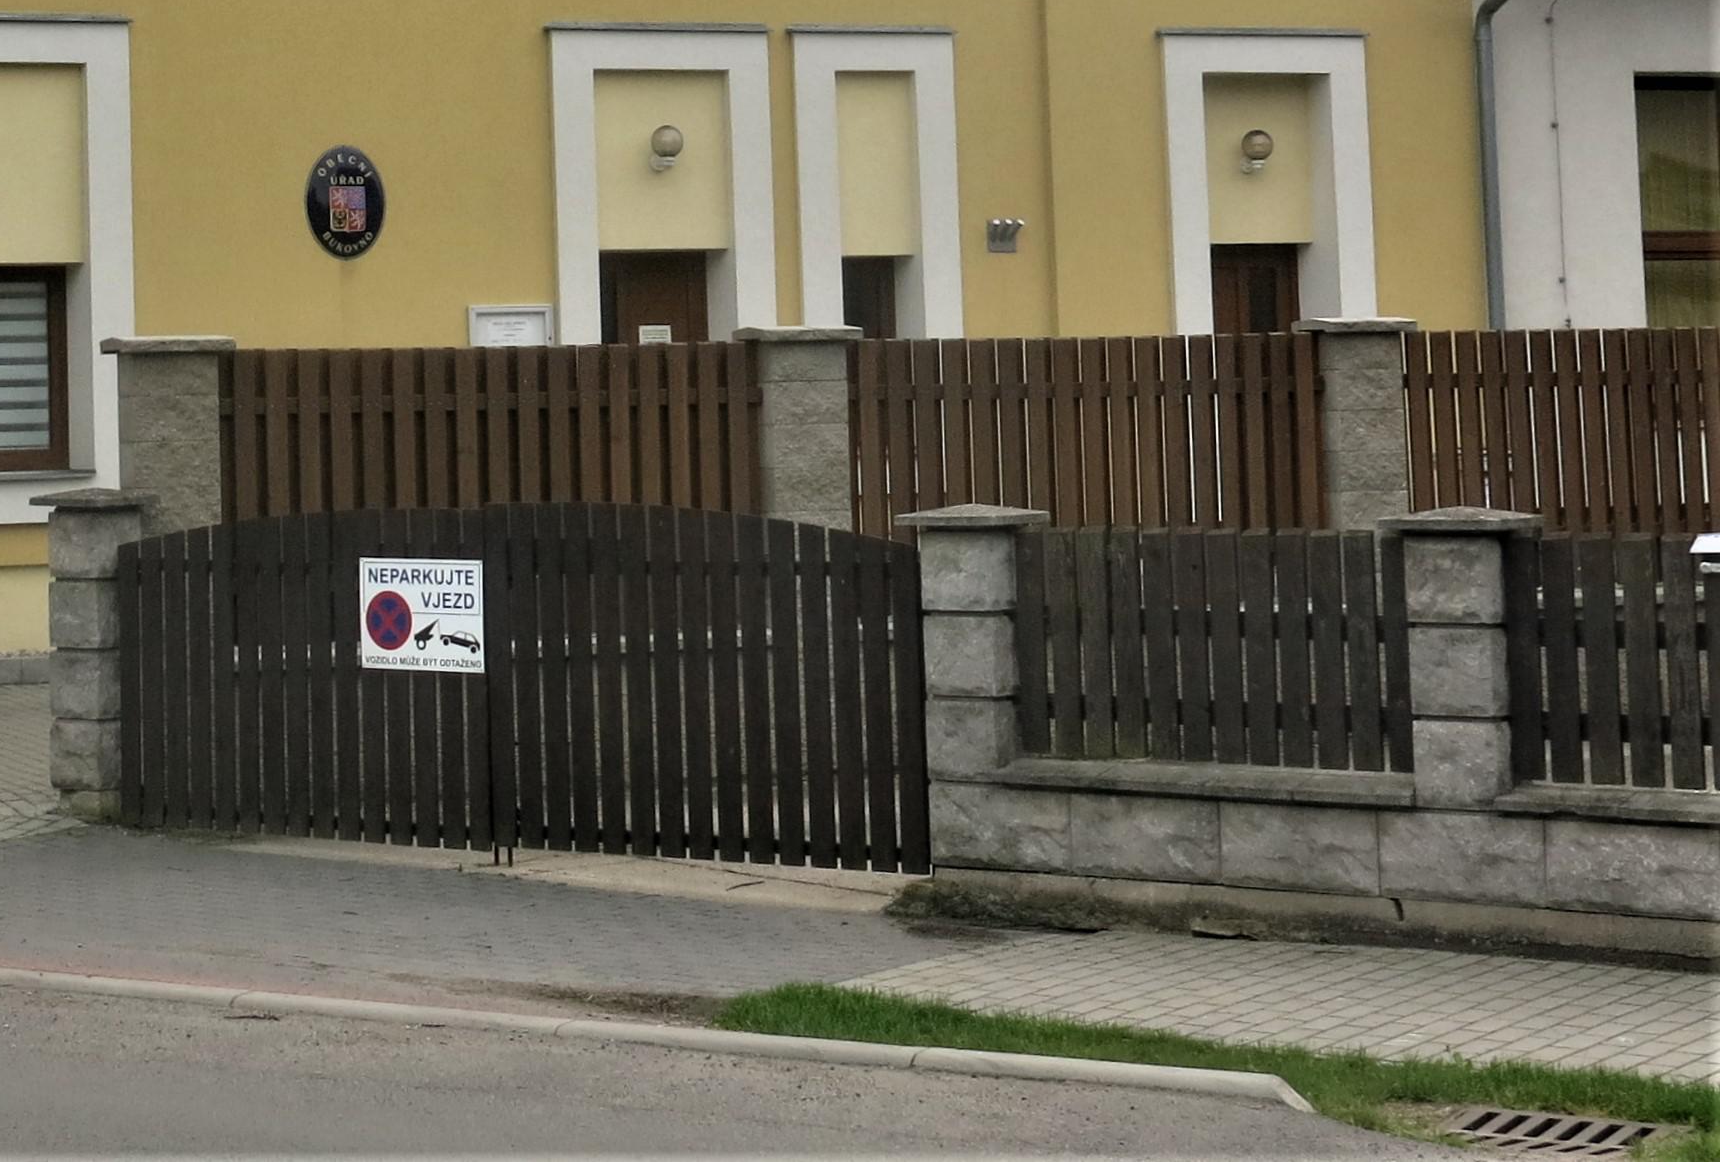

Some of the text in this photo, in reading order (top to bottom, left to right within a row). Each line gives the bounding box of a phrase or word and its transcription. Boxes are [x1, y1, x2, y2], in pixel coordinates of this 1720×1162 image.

[317, 153, 373, 178] OBECNÍ
[330, 174, 365, 185] ÚŘAD
[322, 231, 374, 253] BUKOVNO
[368, 568, 474, 586] NEPARKUJTE
[421, 592, 475, 609] VJEZD
[365, 656, 398, 665] VOZIDLO
[440, 658, 482, 669] ODTAŽENO
